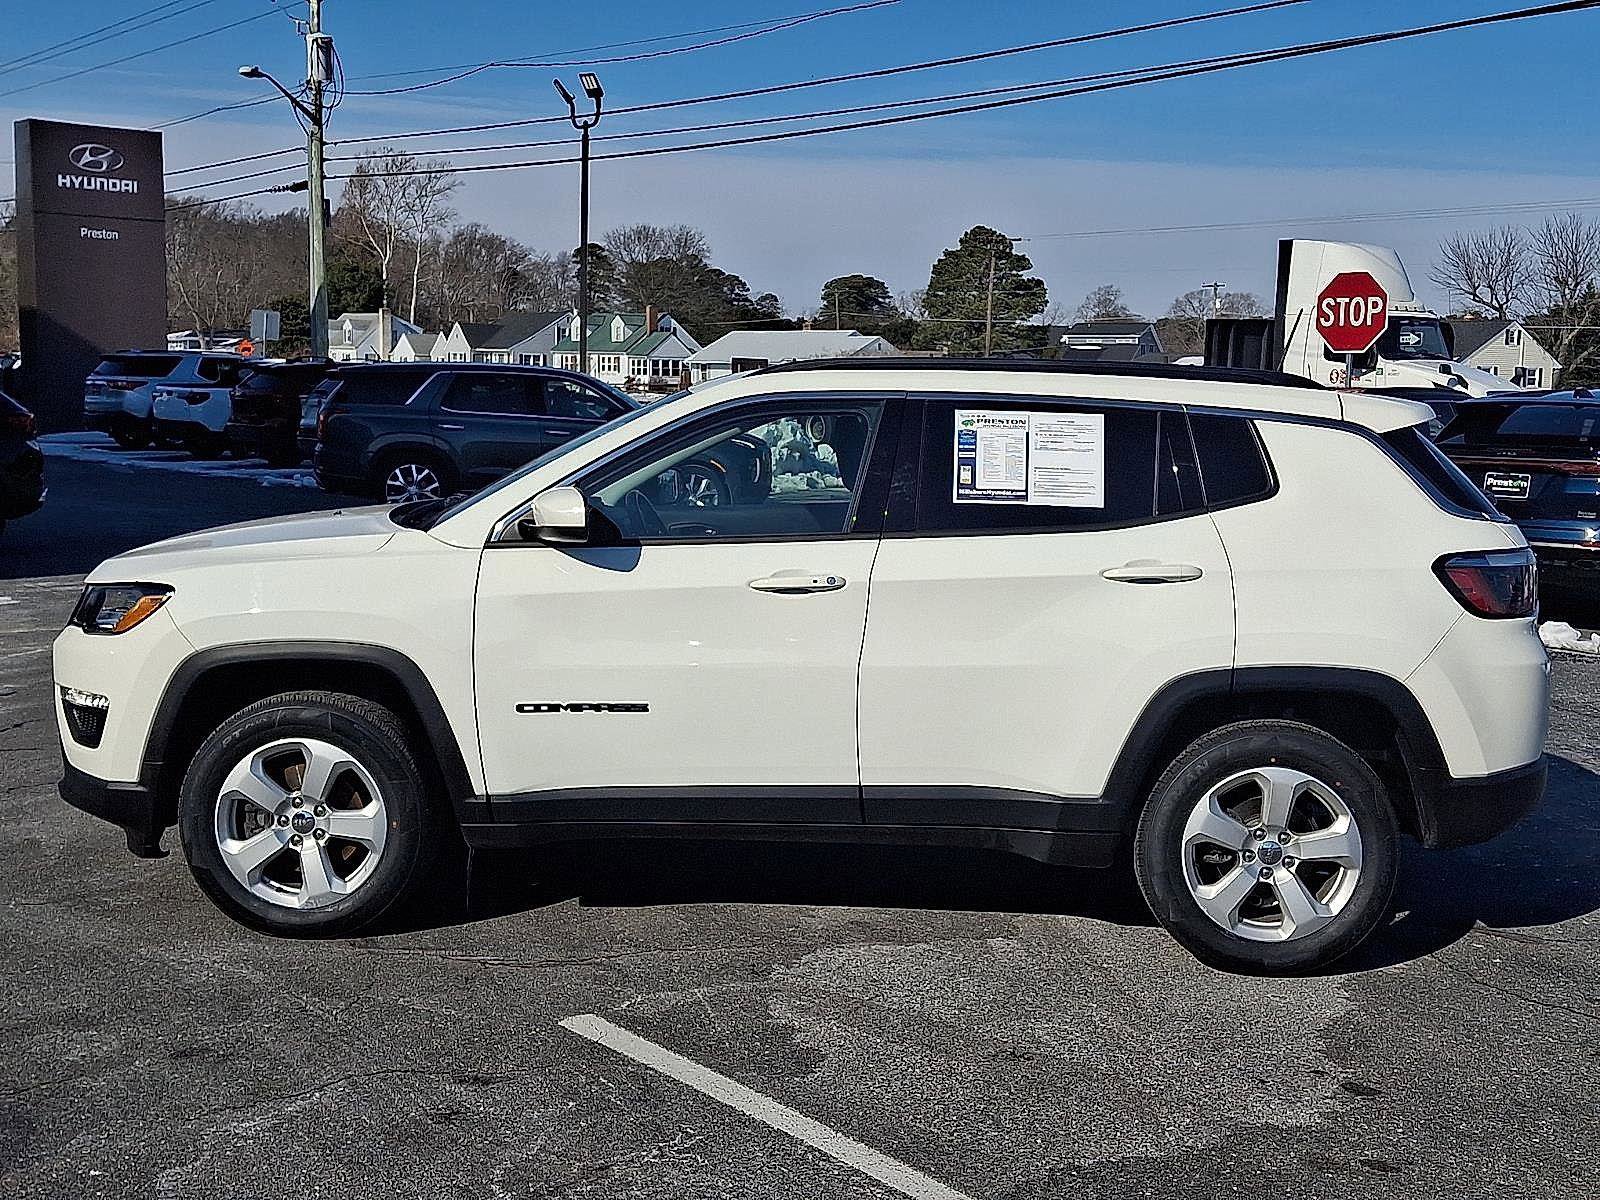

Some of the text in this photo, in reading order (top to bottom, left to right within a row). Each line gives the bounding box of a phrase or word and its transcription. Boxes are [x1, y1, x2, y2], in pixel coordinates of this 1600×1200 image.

[57, 174, 138, 193] HYUNDAI
[80, 227, 119, 240] Preston
[1320, 296, 1383, 327] STOP
[1486, 477, 1528, 488] Preston
[515, 702, 650, 713] COMPASS
